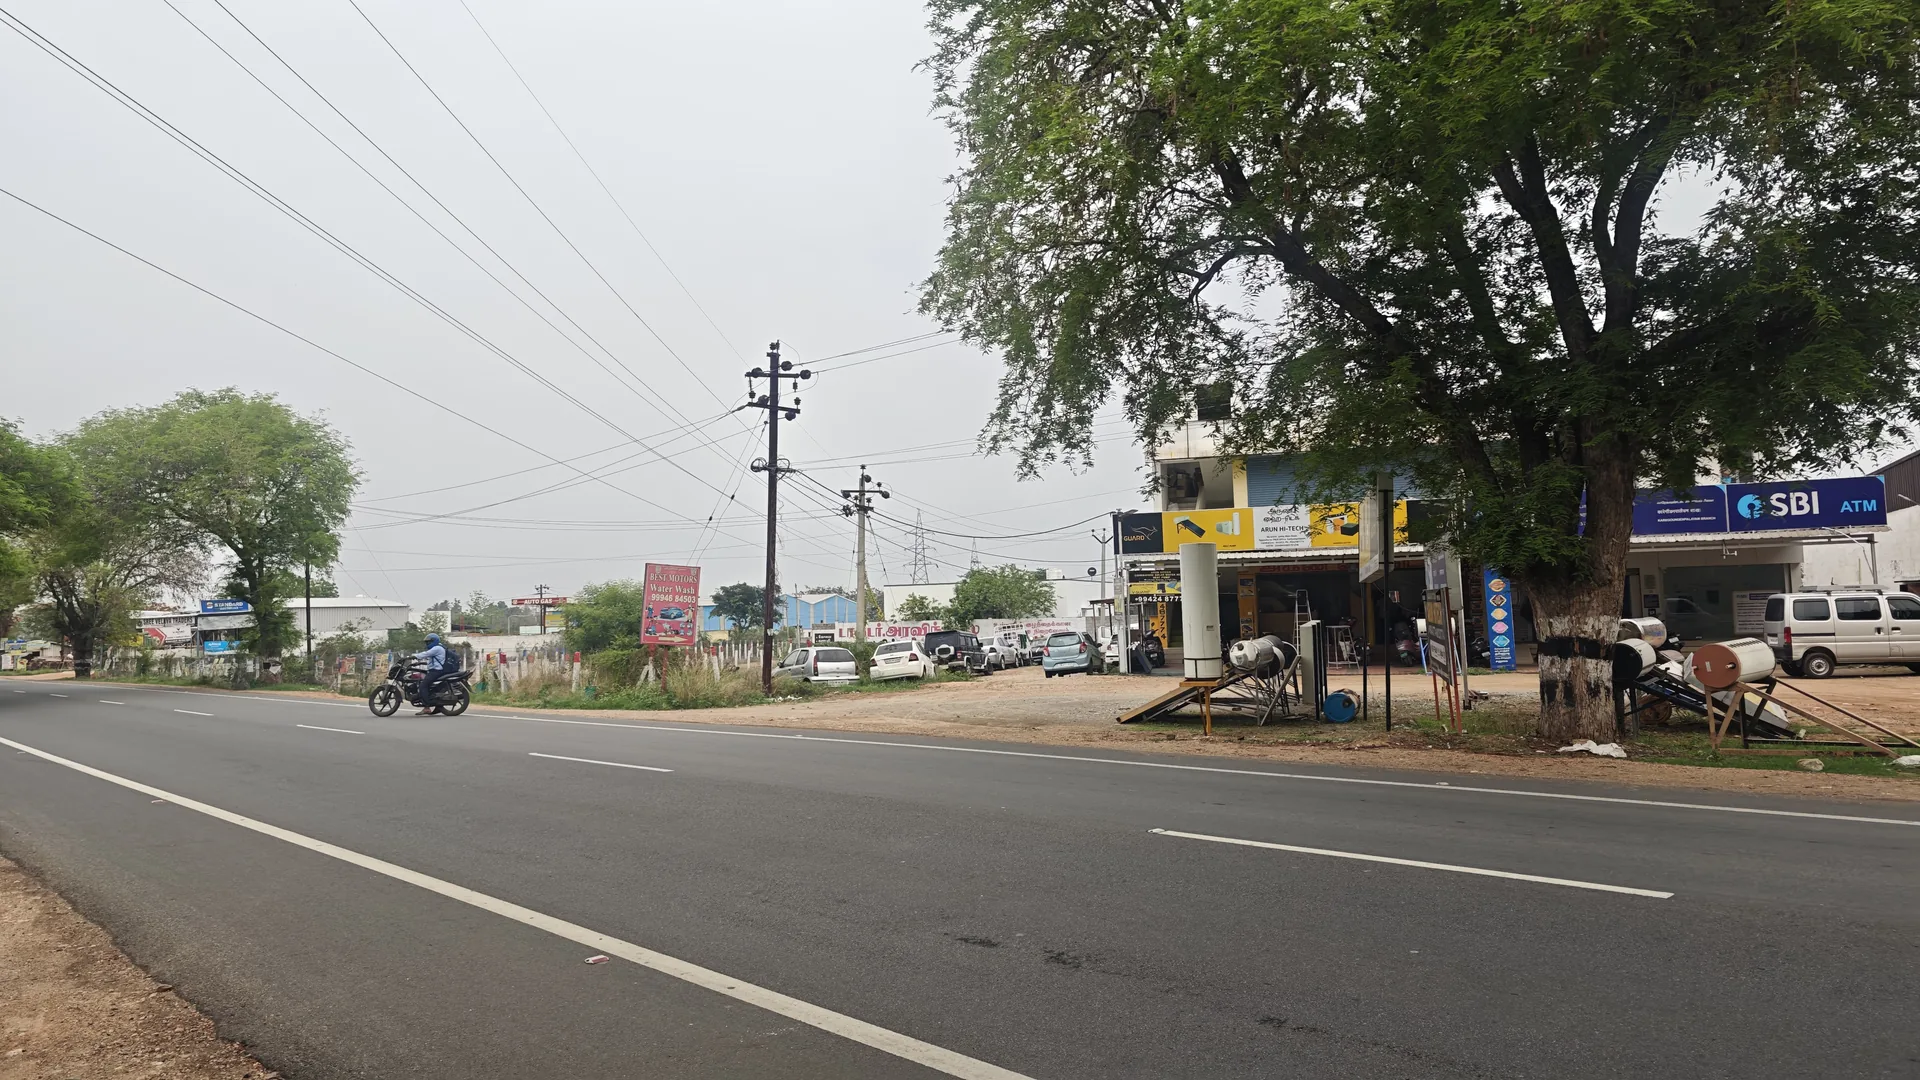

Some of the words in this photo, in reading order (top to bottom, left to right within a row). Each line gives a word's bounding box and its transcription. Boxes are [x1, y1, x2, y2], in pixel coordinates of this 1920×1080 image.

[1769, 491, 1819, 517] SBI
[1840, 499, 1877, 513] ATM
[650, 573, 668, 581] BEST
[669, 574, 698, 583] MOTORS
[650, 583, 673, 593] Water
[675, 585, 695, 595] Wash
[651, 593, 673, 602] 99946
[674, 595, 696, 603] 84503
